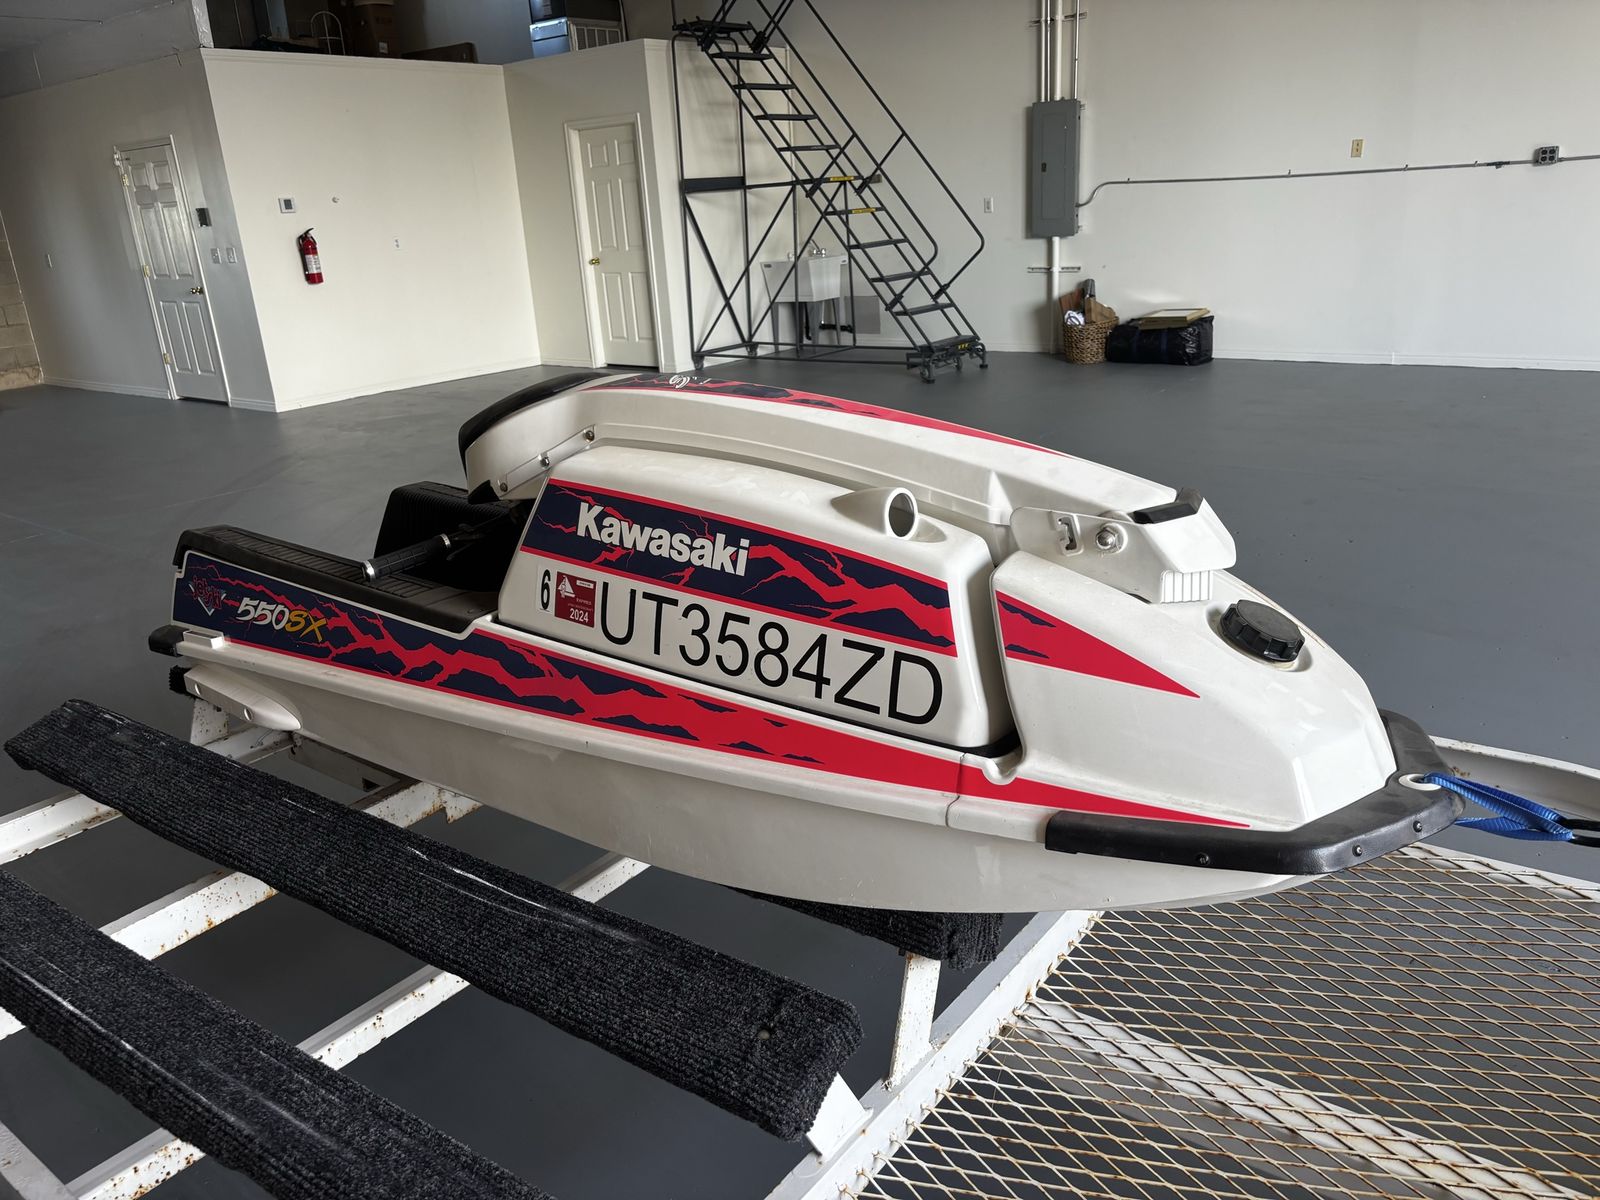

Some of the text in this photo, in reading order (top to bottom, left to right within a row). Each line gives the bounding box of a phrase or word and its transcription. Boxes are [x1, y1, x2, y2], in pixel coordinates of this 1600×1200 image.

[577, 502, 750, 577] Kawasaki
[541, 569, 551, 610] 6
[236, 597, 327, 642] 550SX
[569, 608, 589, 623] 2024
[600, 581, 943, 725] UT3584ZD
